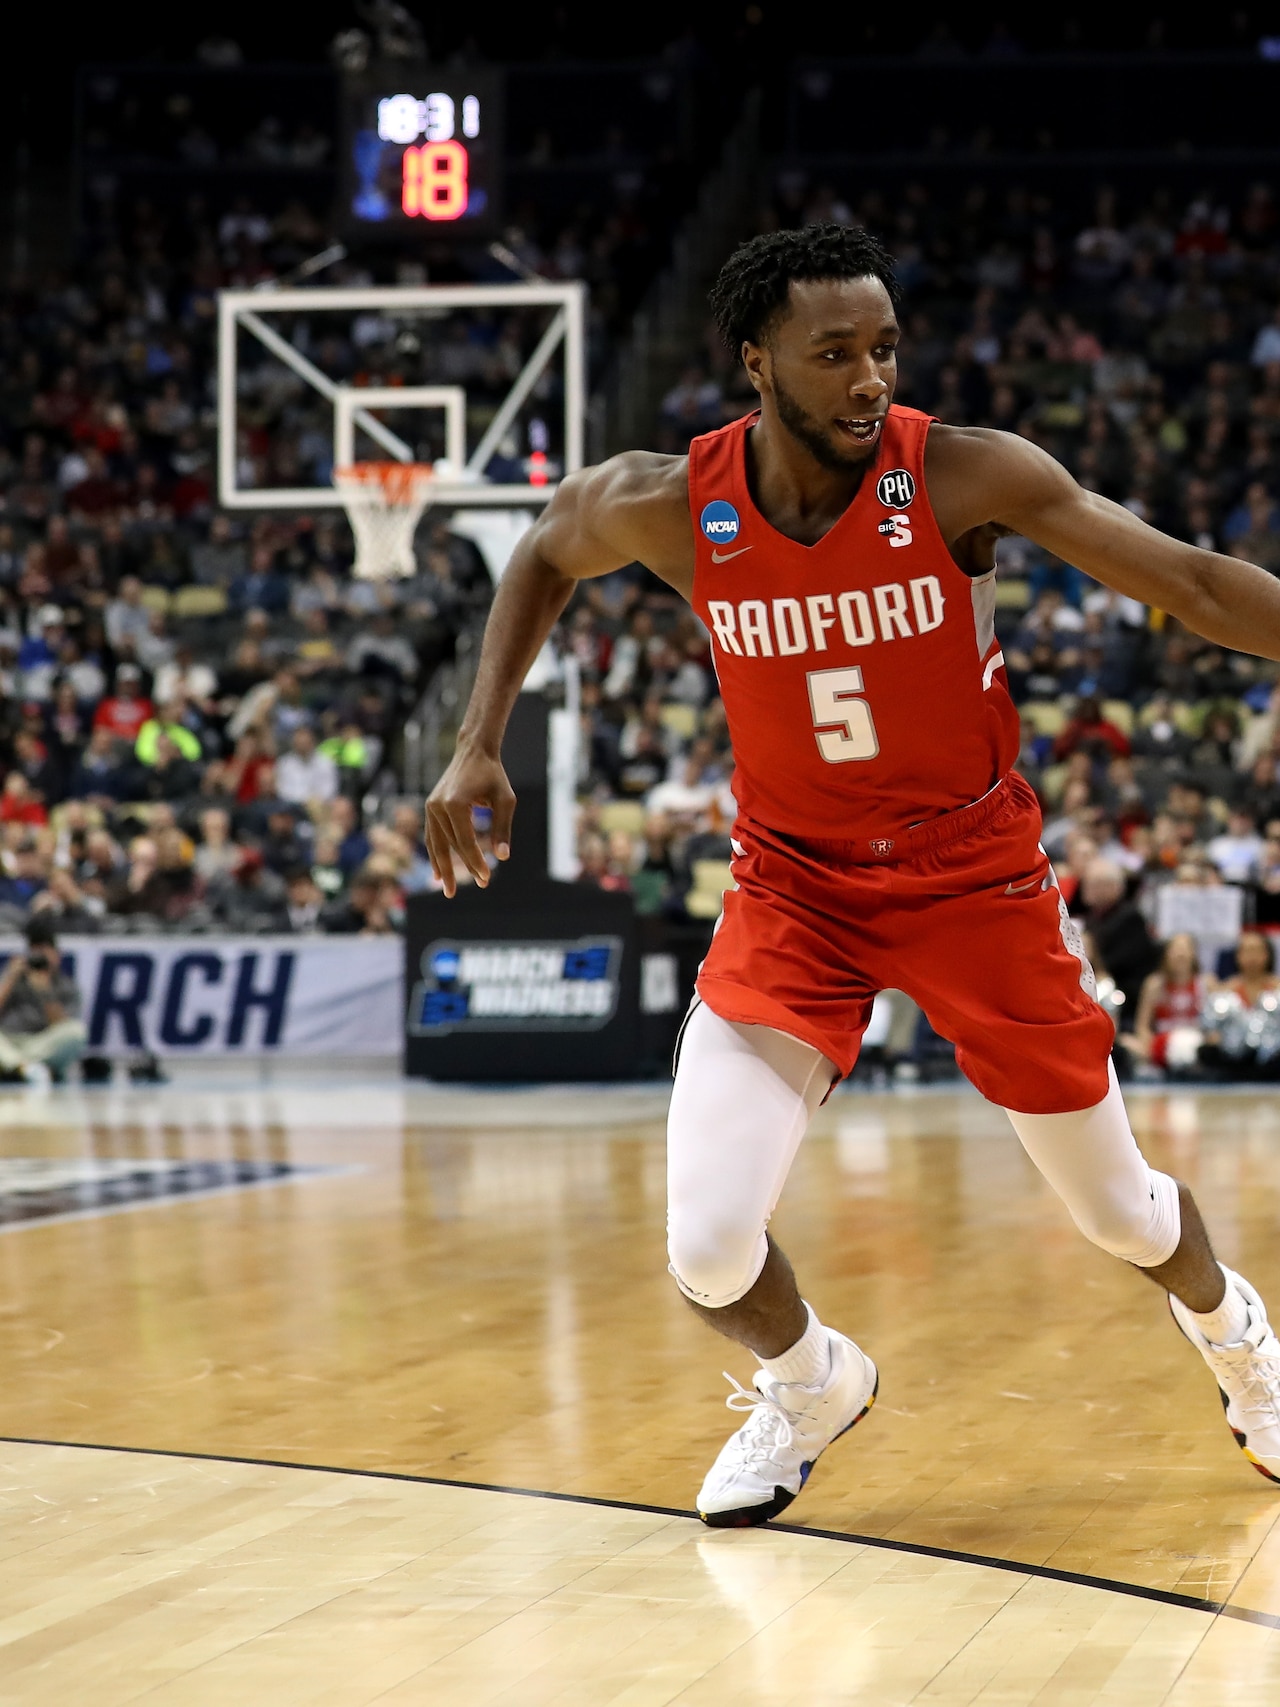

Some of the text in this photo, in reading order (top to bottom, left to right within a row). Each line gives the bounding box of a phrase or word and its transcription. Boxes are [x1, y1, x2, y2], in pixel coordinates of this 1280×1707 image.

[402, 139, 468, 220] 18
[706, 521, 738, 533] NCAA
[878, 523, 896, 532] BIG
[883, 473, 911, 503] PH
[707, 575, 946, 658] RADFORD
[805, 665, 880, 764] 5
[0, 952, 294, 1046] RCH
